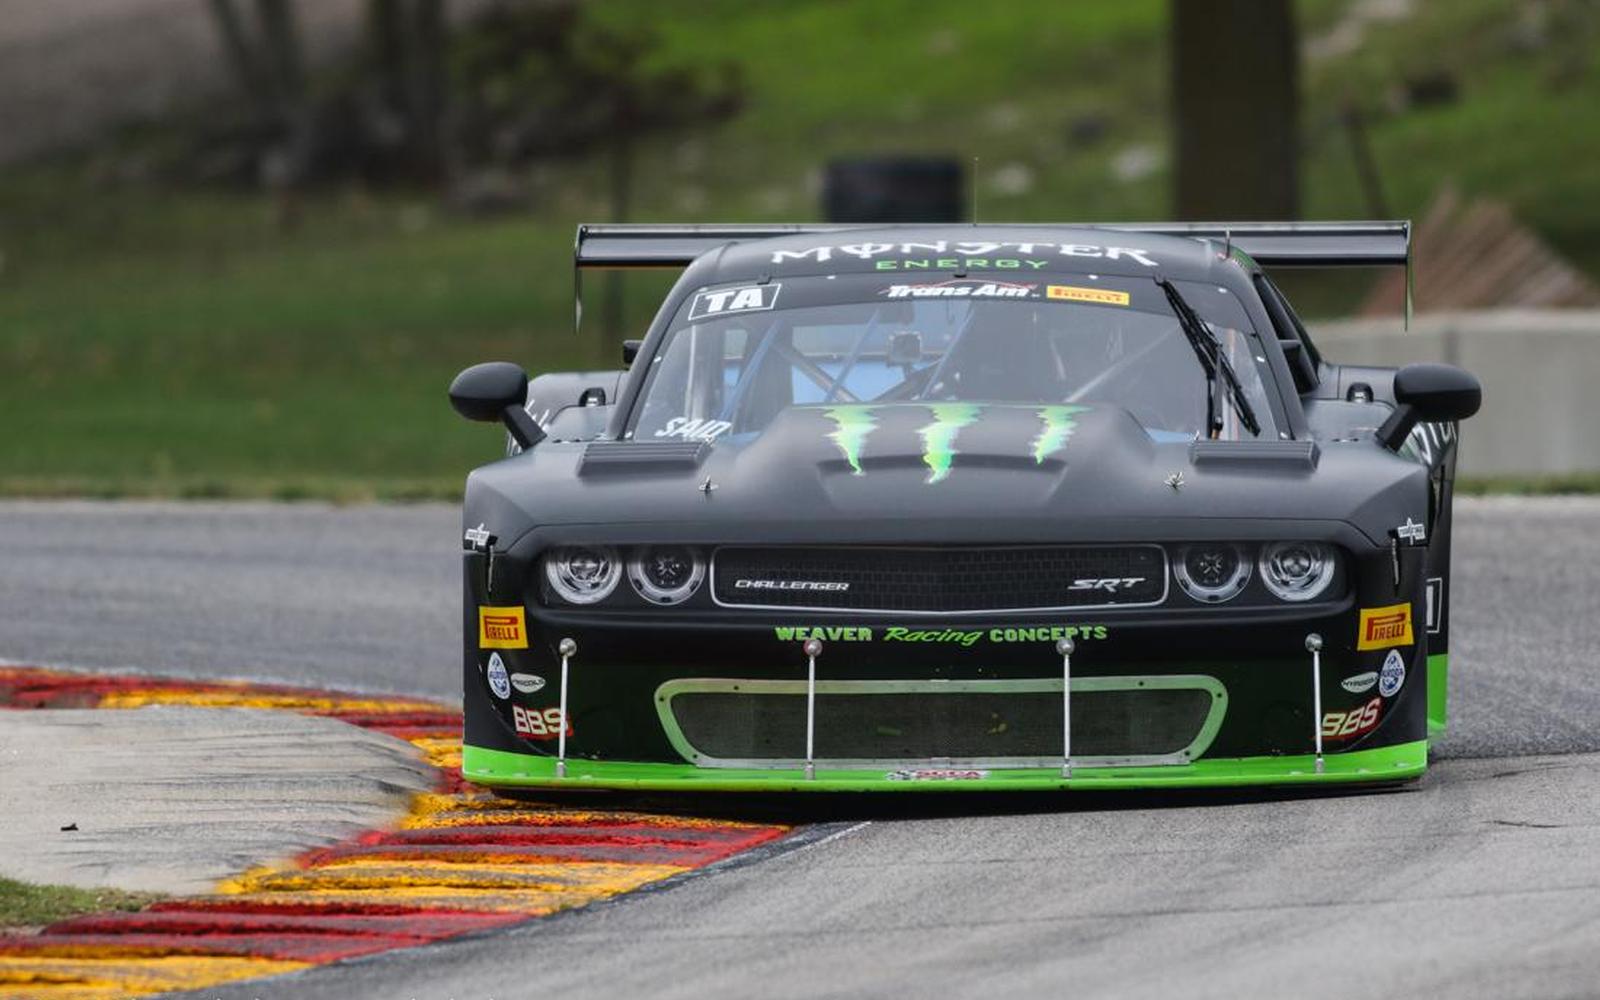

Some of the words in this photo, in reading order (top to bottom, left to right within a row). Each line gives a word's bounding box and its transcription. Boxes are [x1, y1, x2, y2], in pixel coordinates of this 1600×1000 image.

[771, 241, 1159, 266] MONSTER
[875, 259, 1048, 269] ENERGY
[705, 288, 762, 312] TA
[888, 285, 972, 297] Trans
[972, 284, 1029, 296] Am
[653, 416, 732, 439] SAID
[735, 579, 849, 591] CHALLENGER
[1067, 577, 1146, 592] SRT
[484, 615, 519, 641] PIRELLI
[775, 627, 873, 641] WEAVER
[883, 627, 984, 646] Racing
[989, 626, 1107, 642] CONCEPTS
[1365, 612, 1406, 641] PIRELLI
[512, 705, 569, 735] BBS
[1321, 698, 1380, 737] BBS
